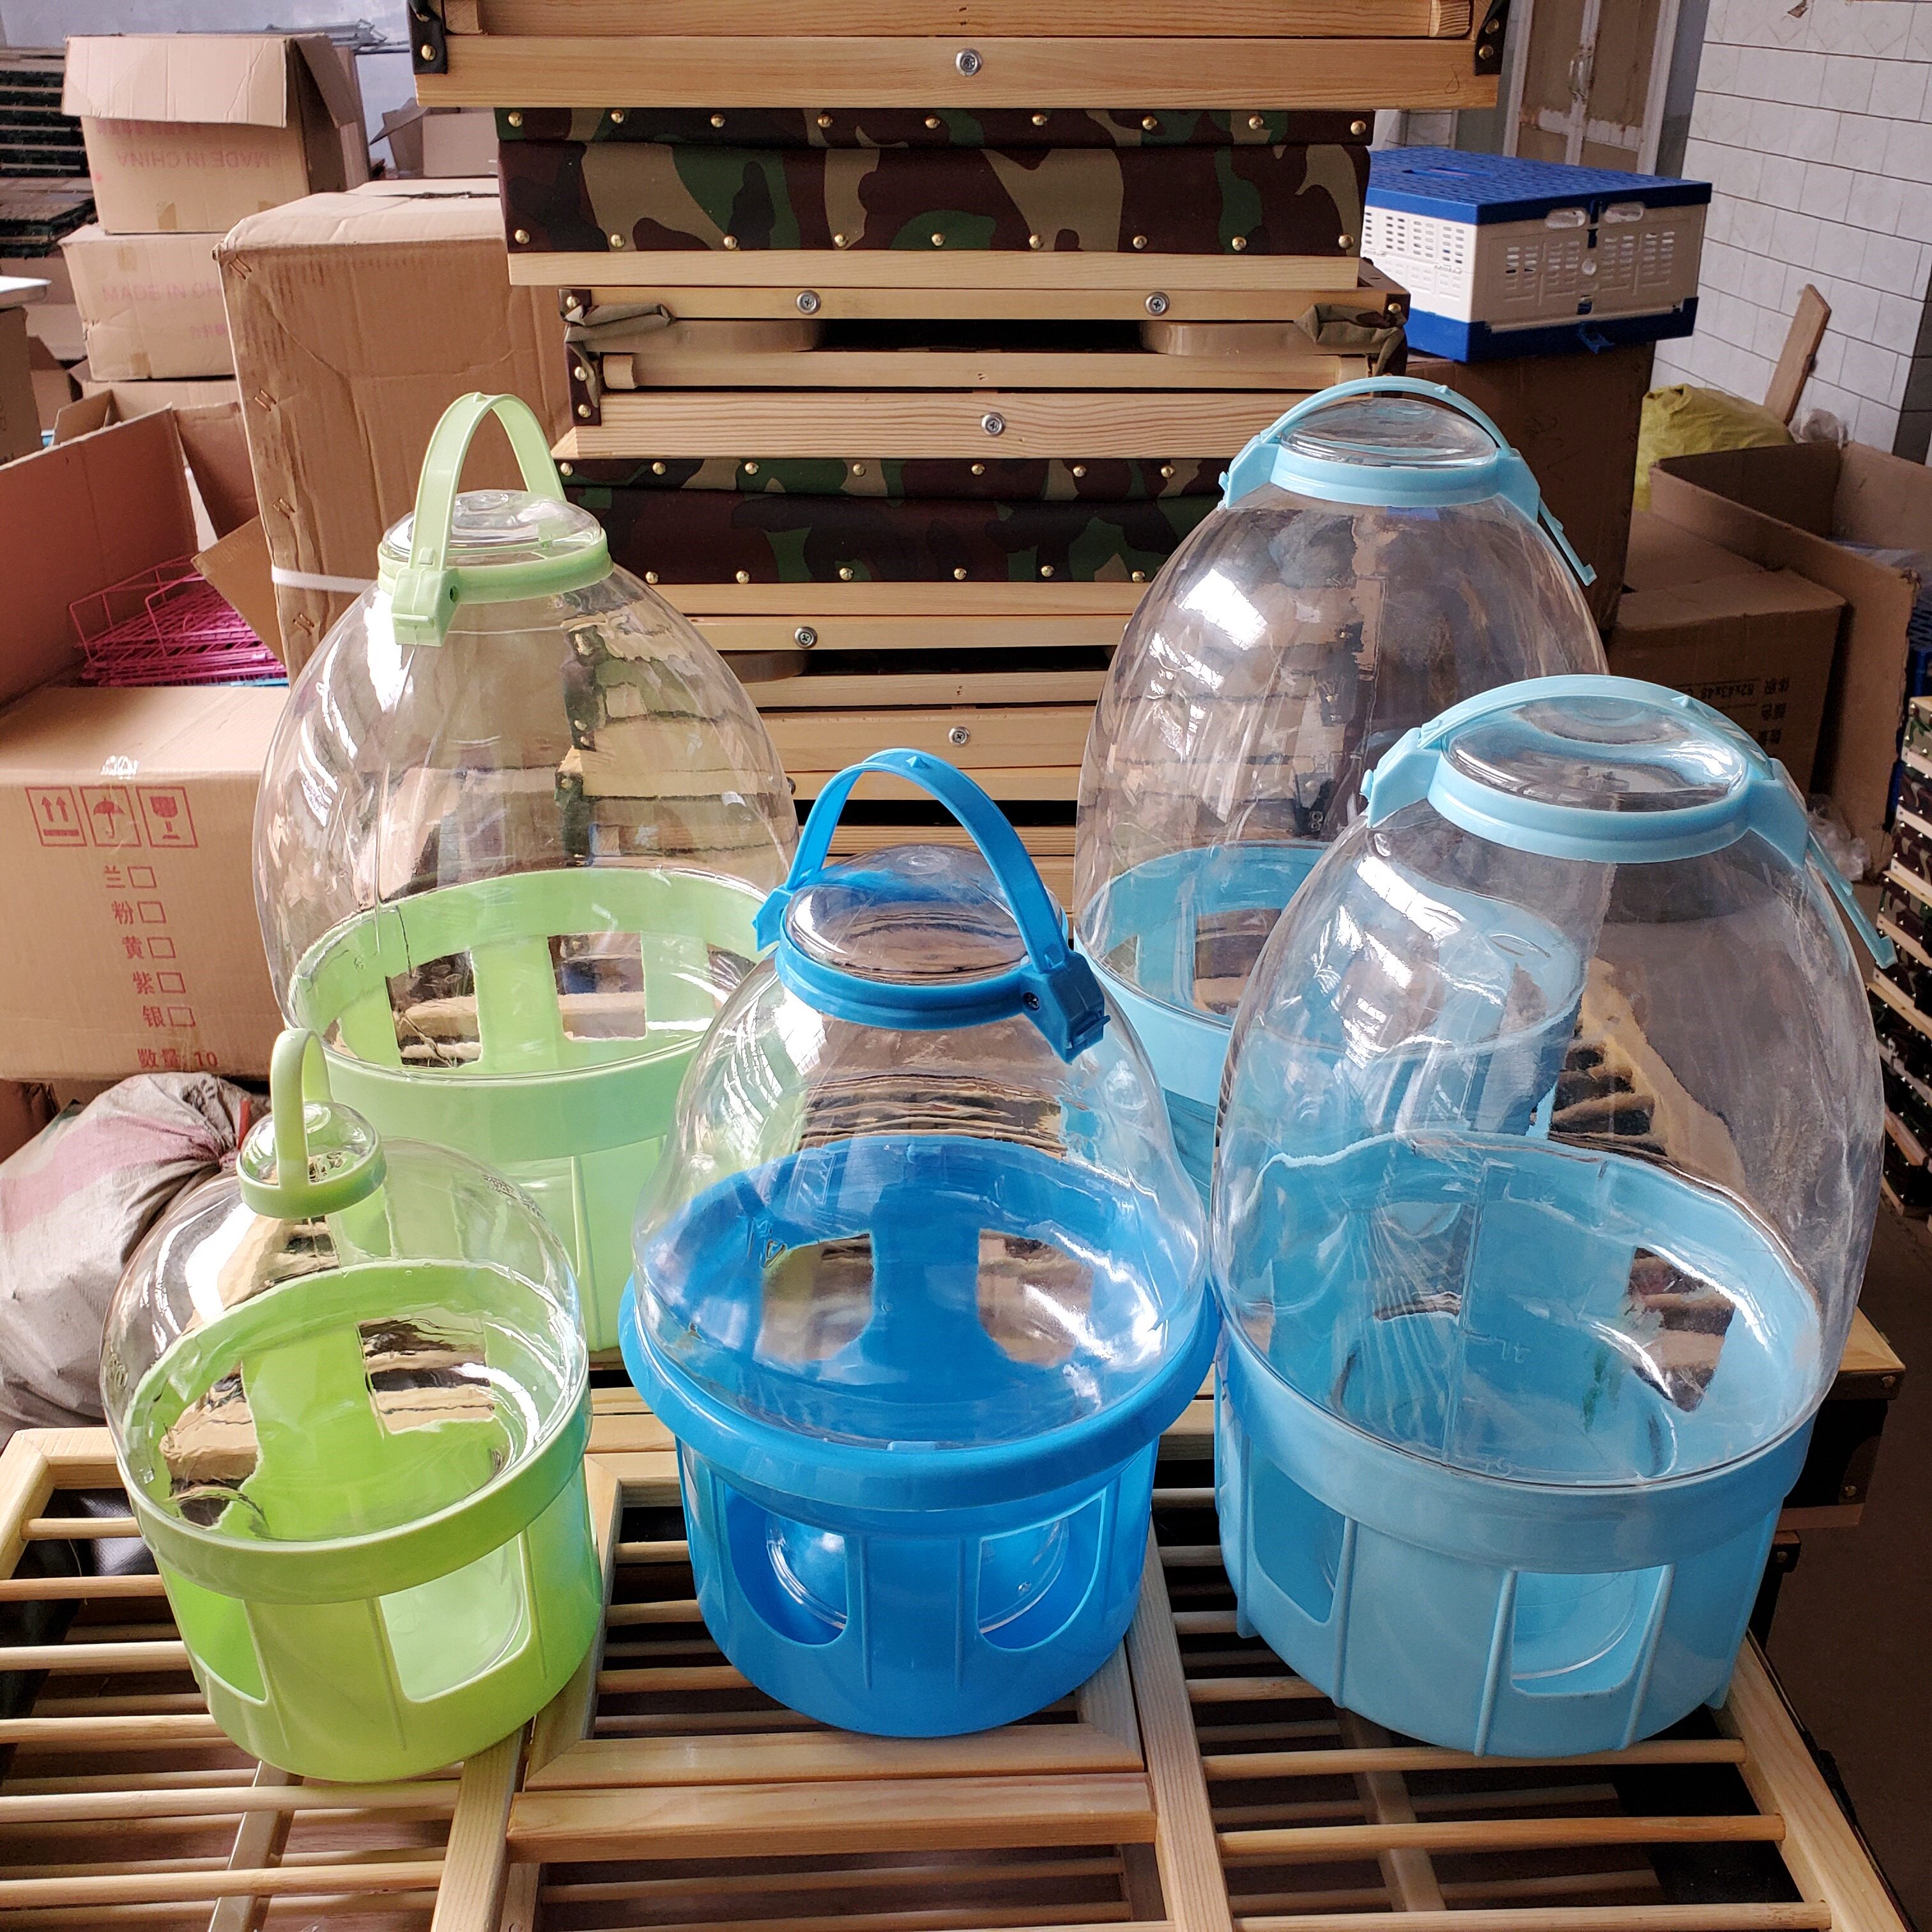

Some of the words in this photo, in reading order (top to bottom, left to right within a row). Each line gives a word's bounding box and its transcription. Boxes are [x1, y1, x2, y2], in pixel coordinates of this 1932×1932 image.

[114, 150, 181, 169] CHINA
[186, 151, 206, 169] IN
[208, 150, 272, 169] MADE
[101, 284, 160, 302] MADE
[166, 283, 187, 299] IN
[103, 865, 126, 888] 兰
[111, 901, 134, 925] 粉
[122, 935, 144, 958] 黄
[132, 970, 155, 995] 紫
[142, 1005, 166, 1027] 银
